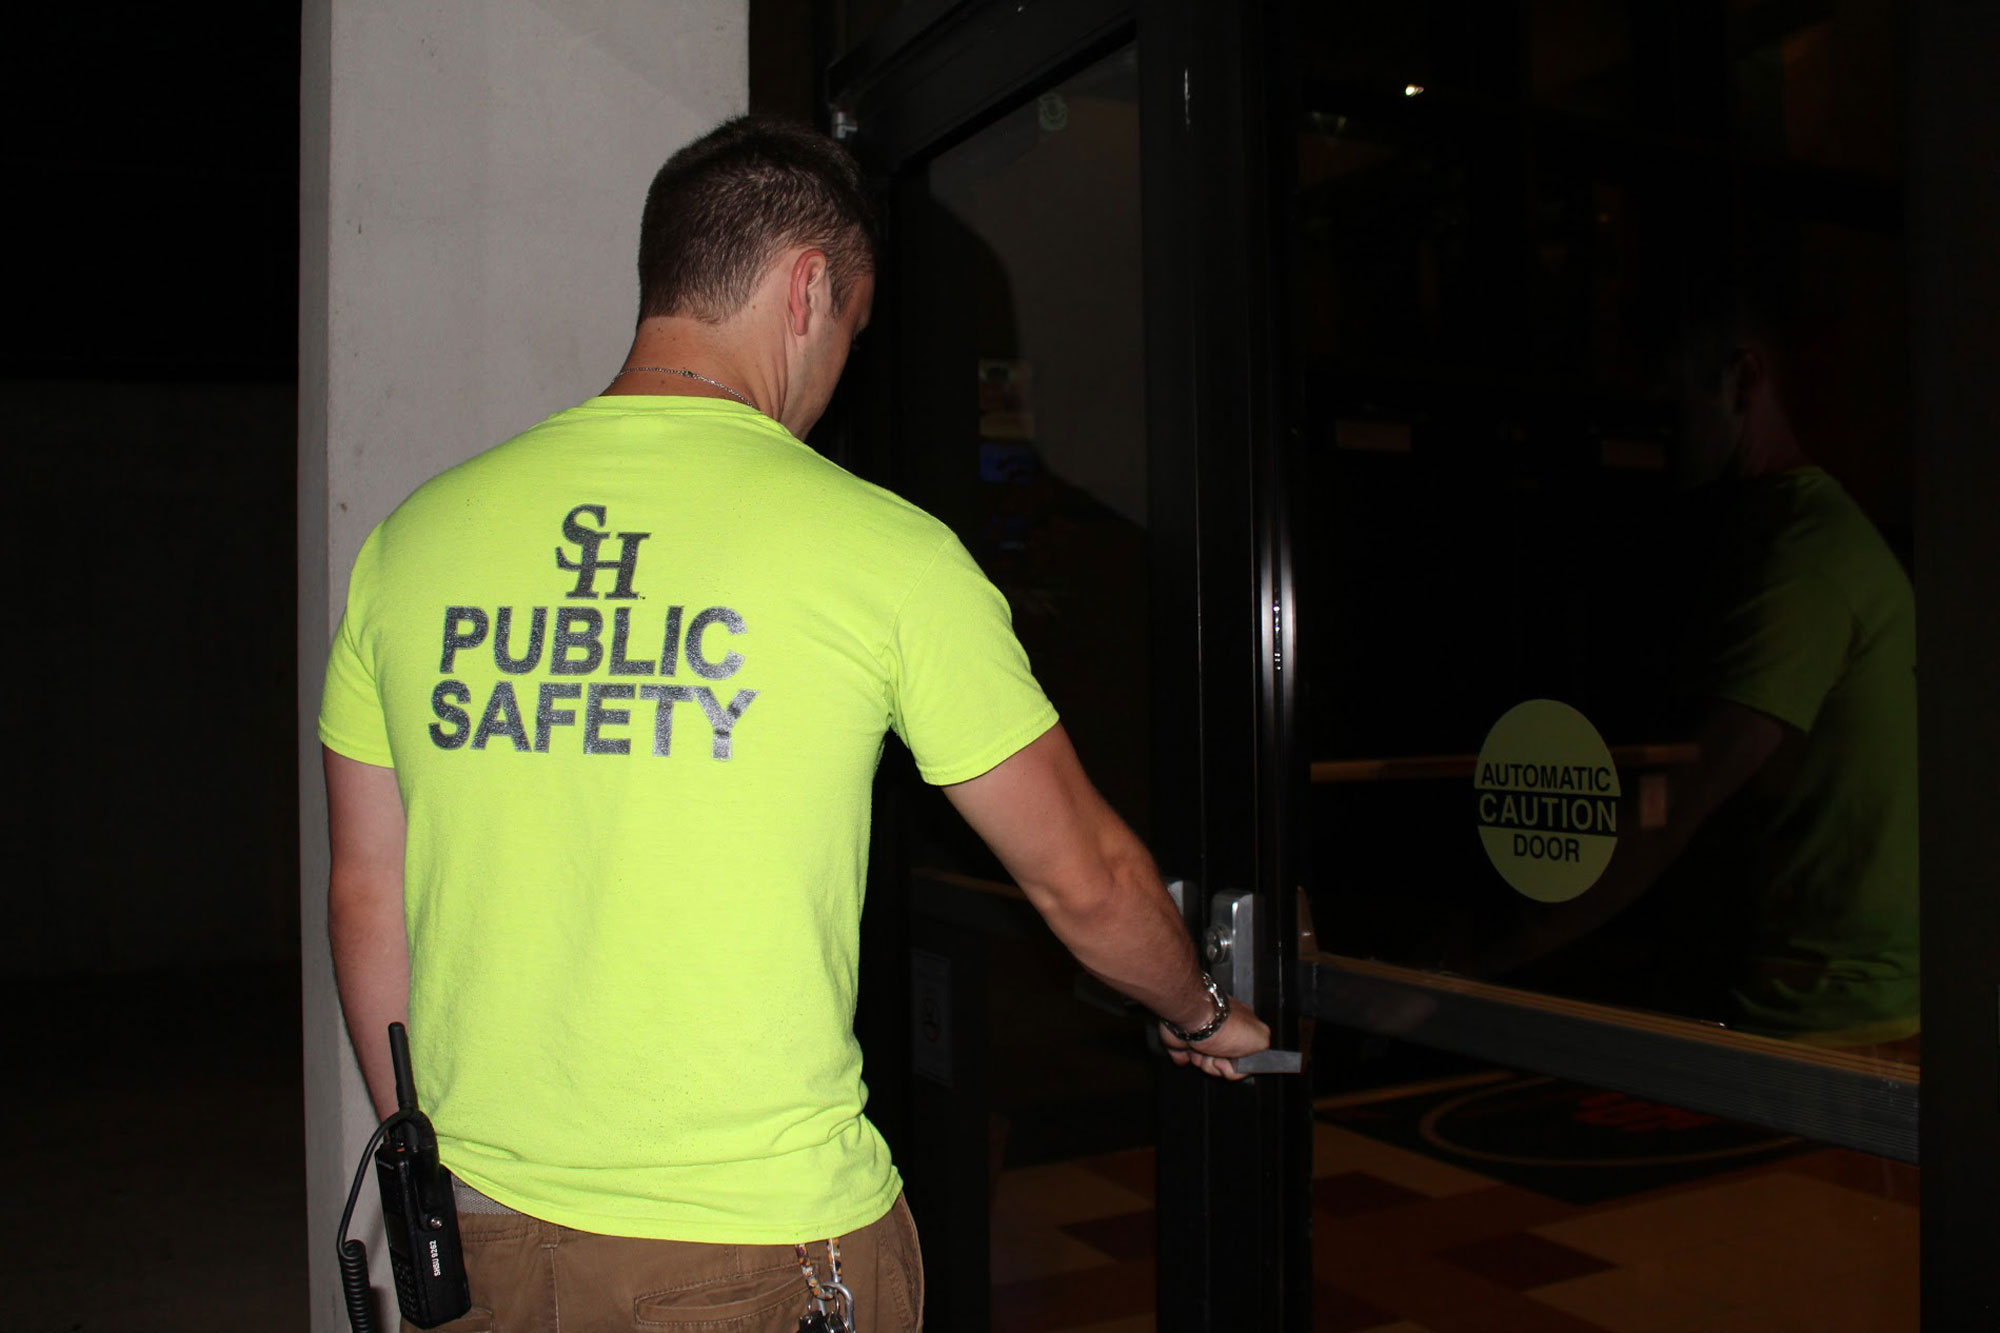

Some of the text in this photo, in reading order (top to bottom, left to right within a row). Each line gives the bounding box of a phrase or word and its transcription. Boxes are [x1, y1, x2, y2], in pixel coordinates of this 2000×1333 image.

[439, 605, 747, 680] PUBLIC
[428, 679, 760, 761] SAFETY
[1481, 763, 1611, 791] AUTOMATIC
[1479, 793, 1617, 832] CAUTION
[1513, 834, 1581, 862] DOOR
